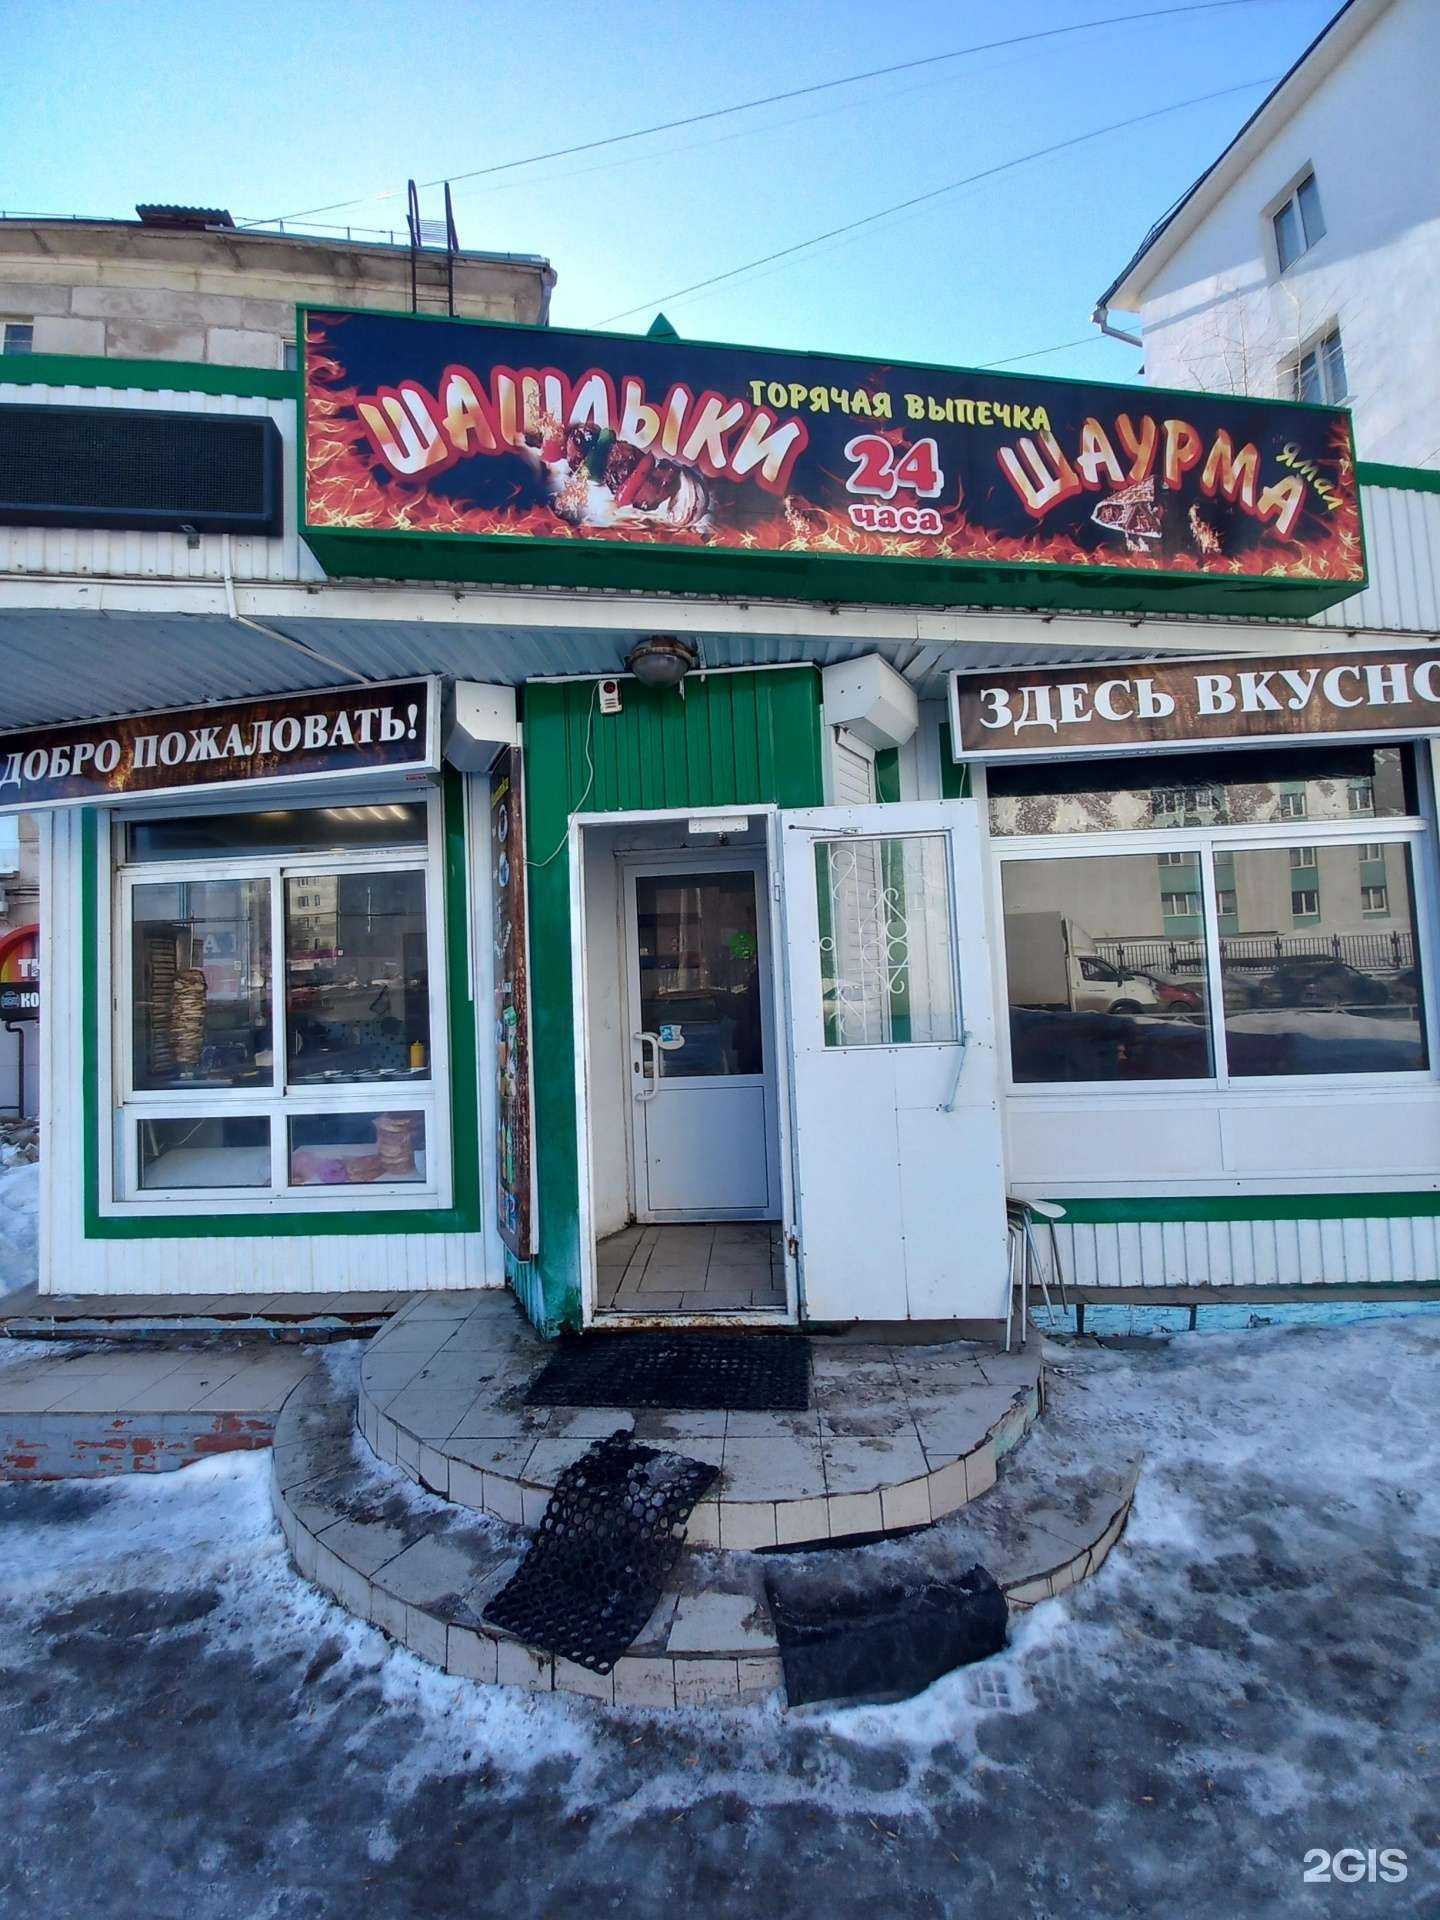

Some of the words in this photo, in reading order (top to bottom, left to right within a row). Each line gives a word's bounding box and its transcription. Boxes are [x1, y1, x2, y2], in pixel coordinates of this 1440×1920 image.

[356, 371, 802, 484] ШАШЛЫКИ
[749, 380, 893, 419] ГОРЯЧАЯ
[903, 393, 1052, 432] ВЫПЕЧКА
[846, 435, 938, 498] 24
[999, 413, 1306, 536] ШАУРМА
[850, 505, 942, 534] часа
[978, 678, 1175, 736] ЗДЕСЬ
[0, 738, 121, 790] ДОБРО
[131, 704, 419, 769] ПОЖАЛОВАТЬ!
